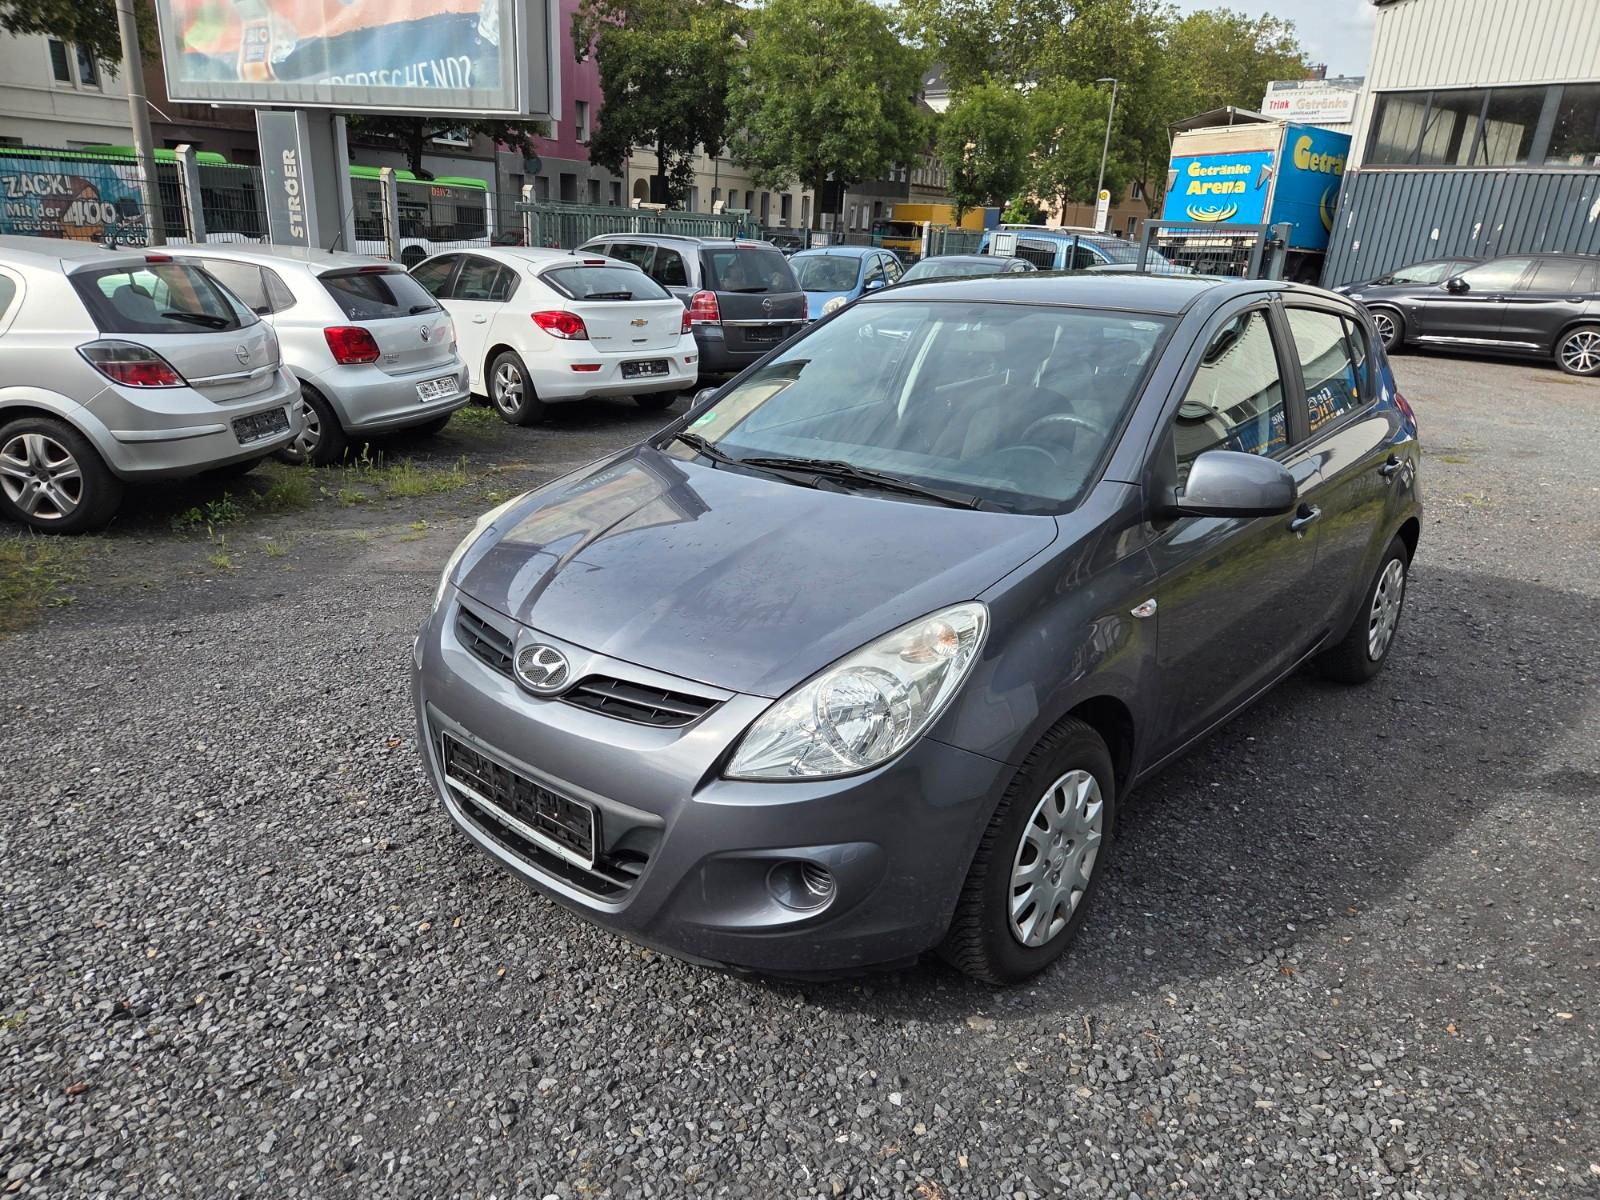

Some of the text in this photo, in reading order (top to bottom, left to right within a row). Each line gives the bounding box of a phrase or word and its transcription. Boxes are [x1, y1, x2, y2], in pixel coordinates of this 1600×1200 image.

[1296, 96, 1349, 110] Getränke
[1187, 162, 1252, 178] Getränke
[2, 174, 73, 199] ZACK!
[282, 149, 304, 239] STRÖER
[1186, 180, 1246, 196] Arena
[5, 201, 61, 217] Mit der
[63, 200, 117, 226] 400
[126, 233, 150, 247] City
